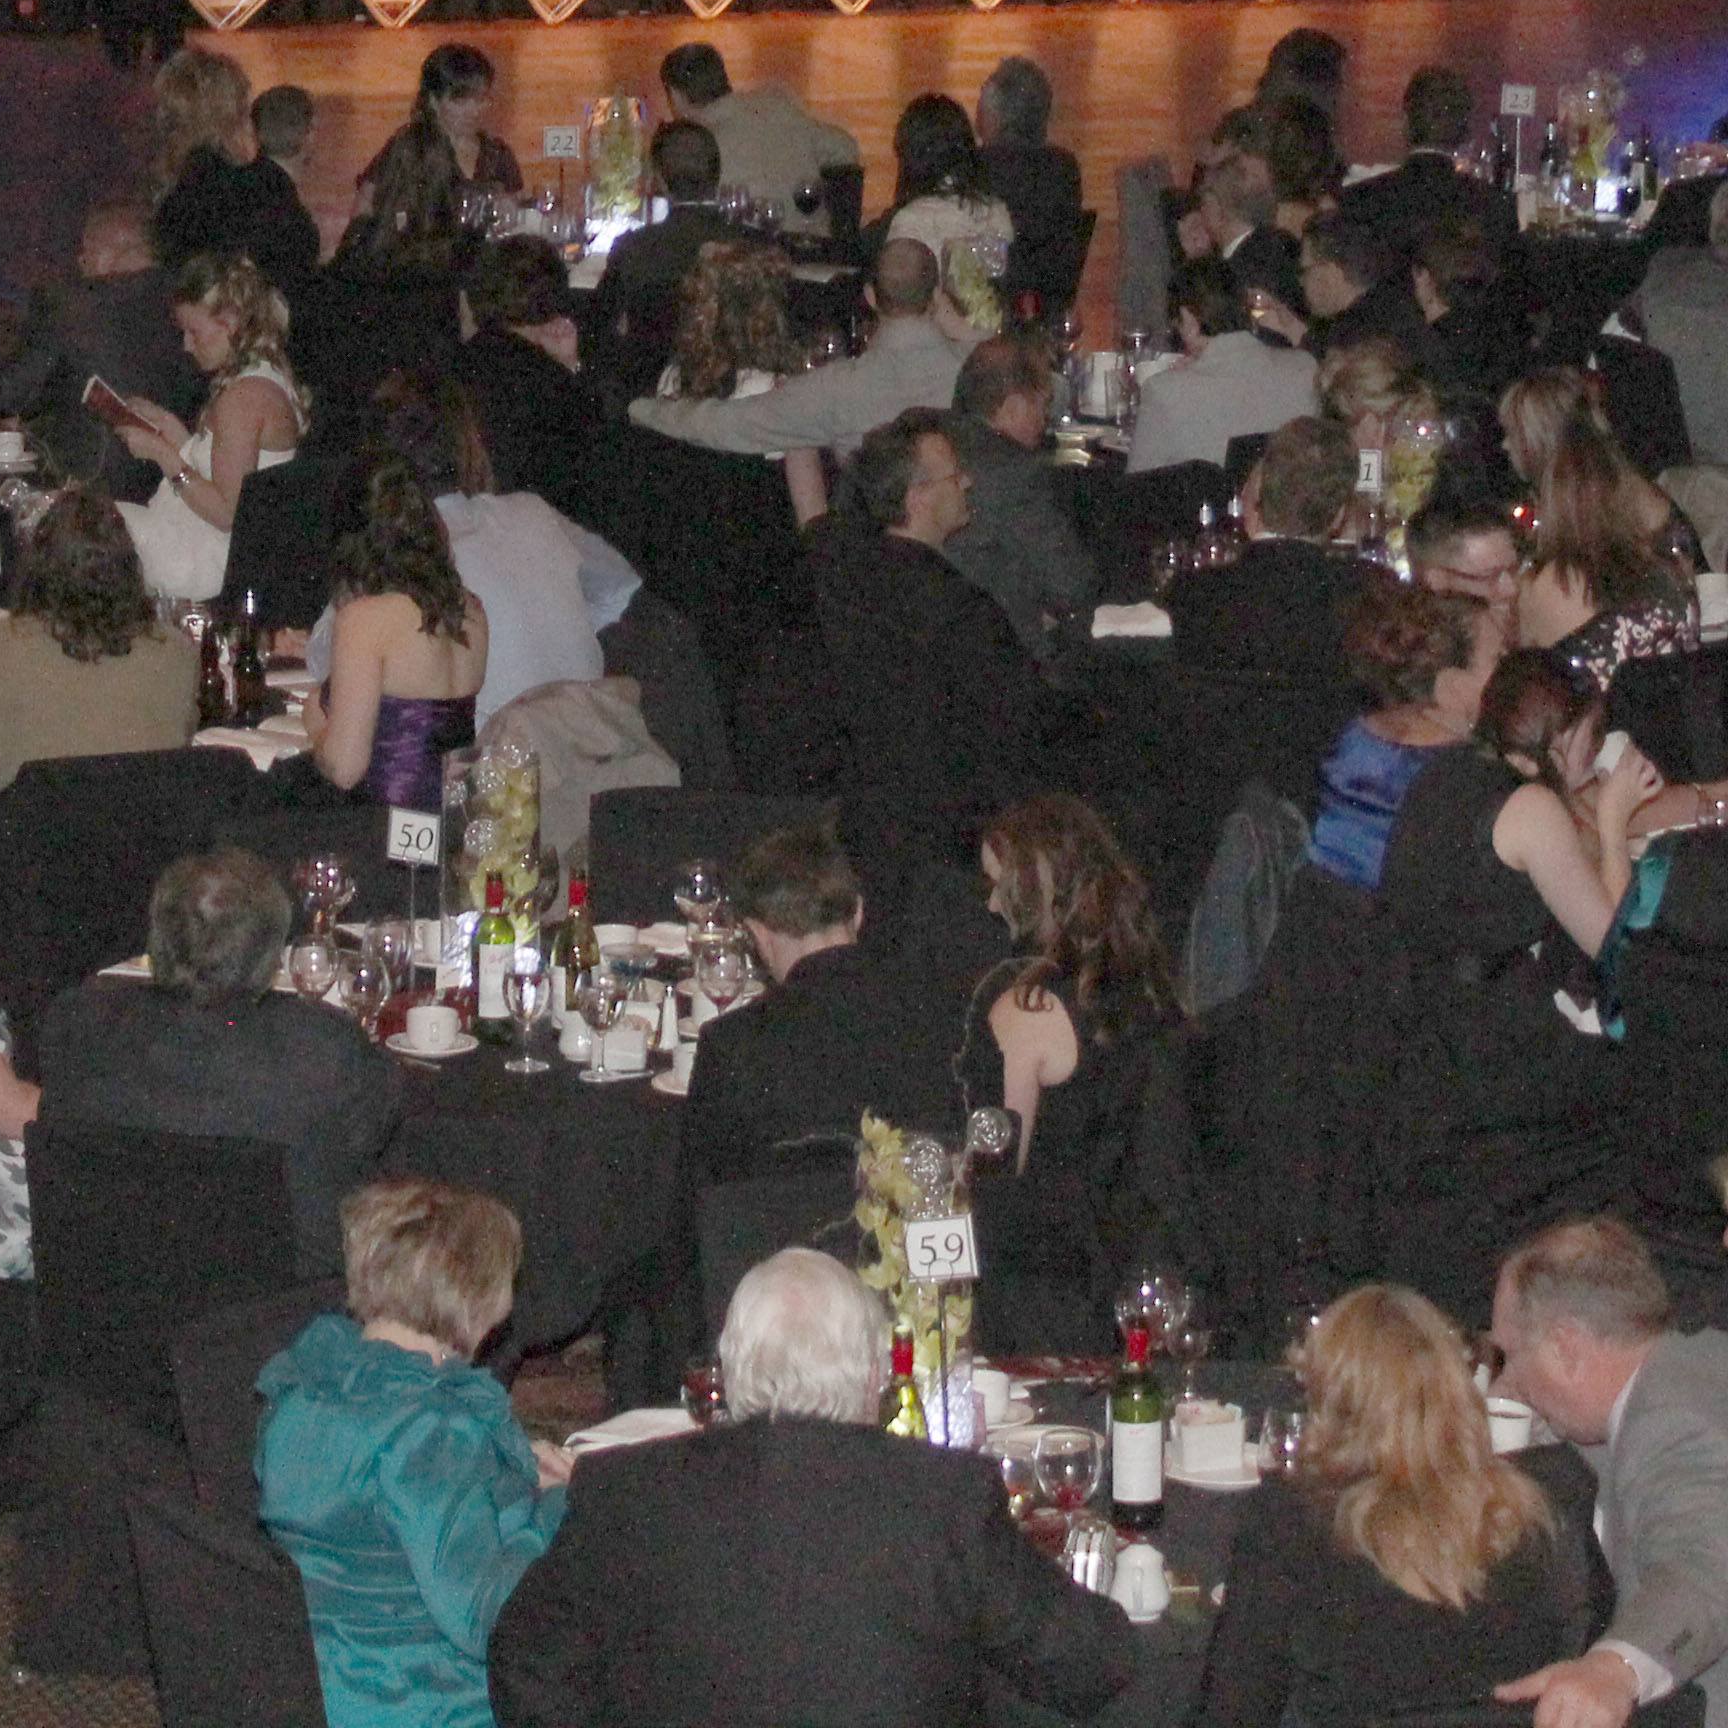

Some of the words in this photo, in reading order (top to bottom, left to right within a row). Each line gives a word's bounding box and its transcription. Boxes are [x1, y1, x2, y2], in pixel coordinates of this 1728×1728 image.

[550, 135, 574, 152] 22
[397, 822, 434, 852] 50
[918, 1231, 964, 1266] 59
